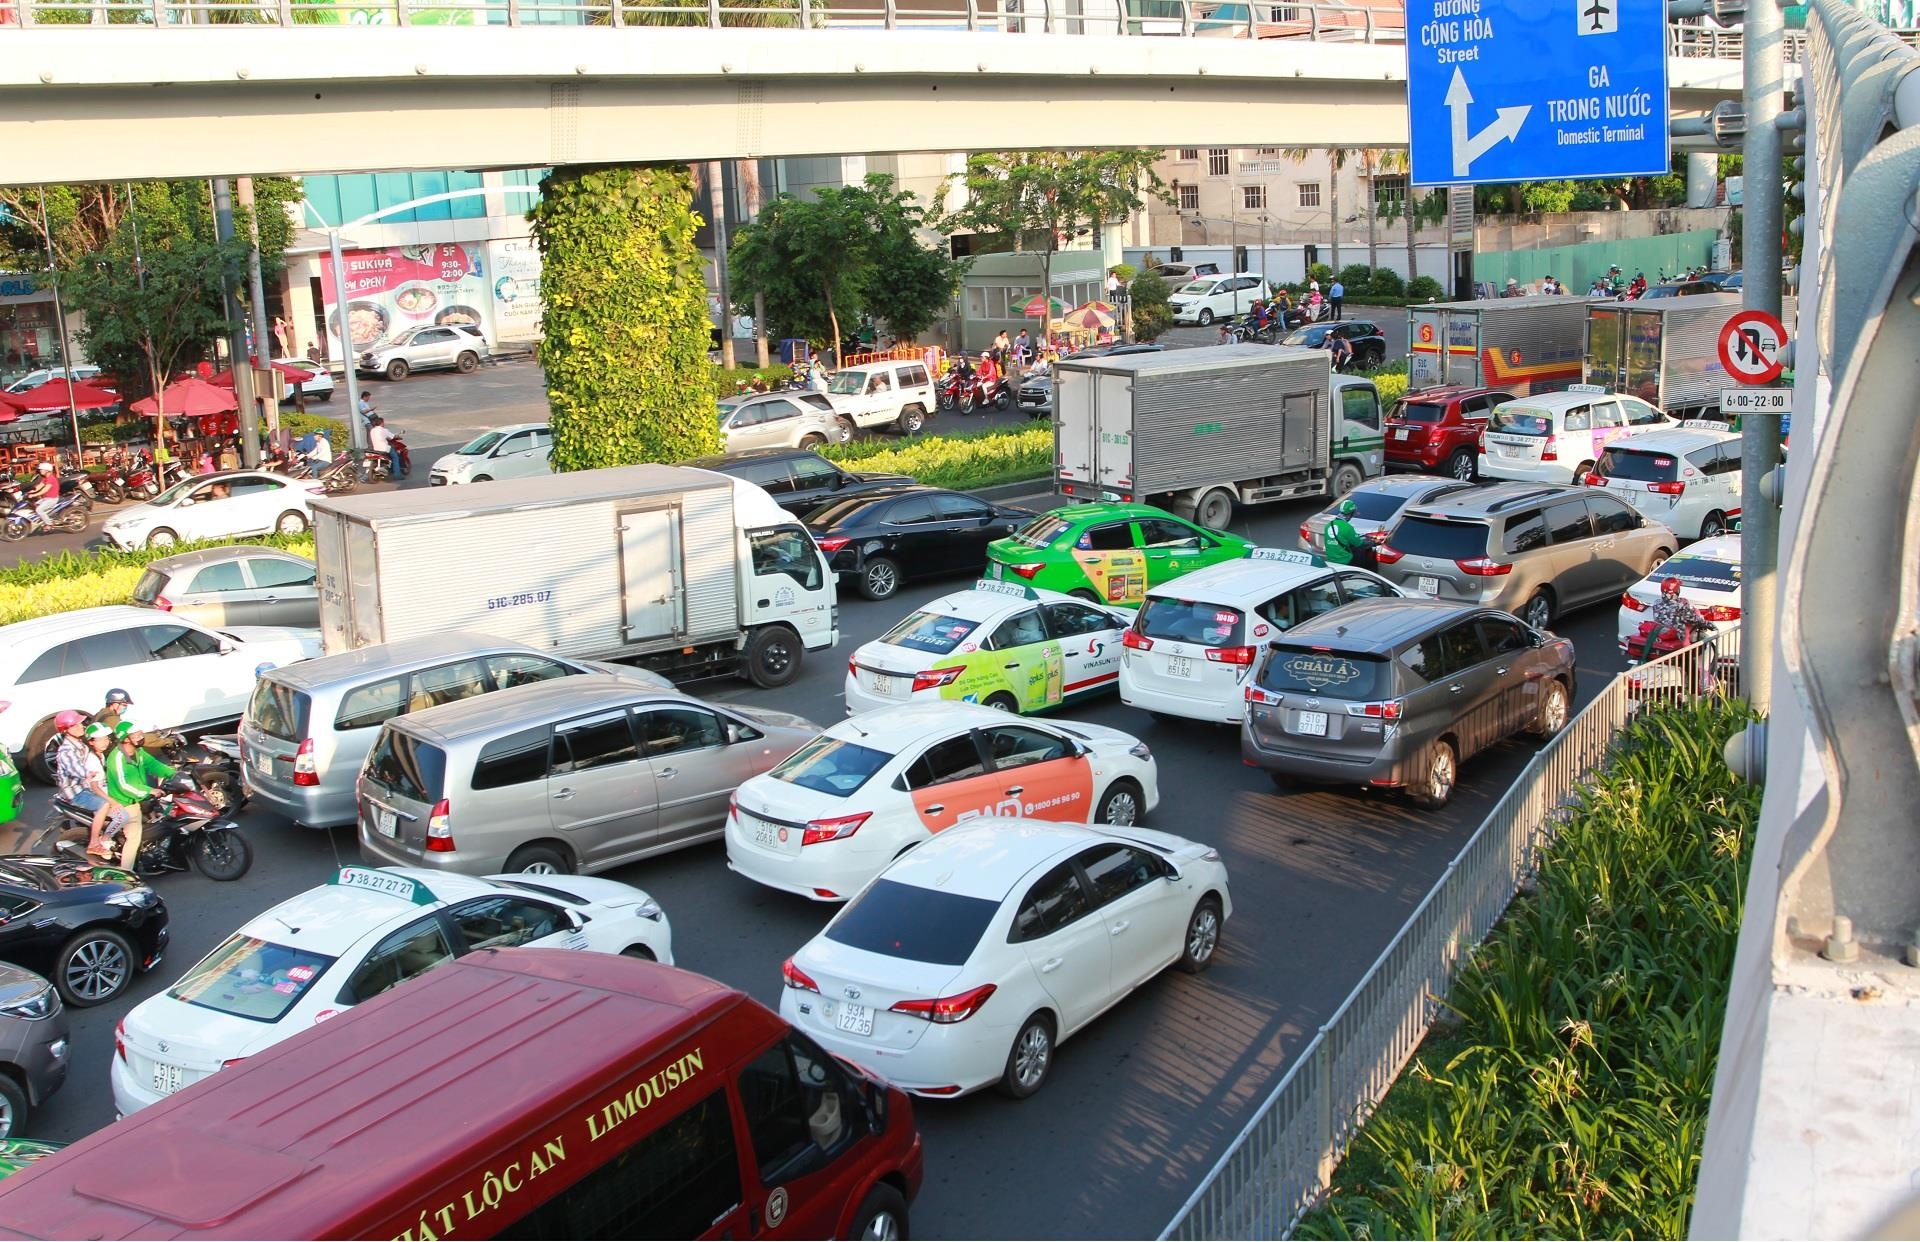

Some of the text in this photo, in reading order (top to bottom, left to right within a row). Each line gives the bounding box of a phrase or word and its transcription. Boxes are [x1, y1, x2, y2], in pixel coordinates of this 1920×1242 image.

[1421, 13, 1494, 49] CỘNG HÒA
[1437, 45, 1479, 64] Street
[1588, 64, 1610, 89] GA
[1547, 86, 1651, 123] TRONG NƯỚC
[1557, 123, 1645, 146] Domestic Terminal
[1293, 658, 1334, 673] CHÂU
[386, 879, 399, 891] 27
[399, 882, 413, 894] 27
[846, 1002, 865, 1018] 93A
[839, 1014, 872, 1034] 127.35
[160, 1063, 176, 1080] 51G
[462, 1170, 524, 1221] LỘC
[529, 1135, 567, 1181] AN
[585, 1047, 704, 1143] LIMOUSIN
